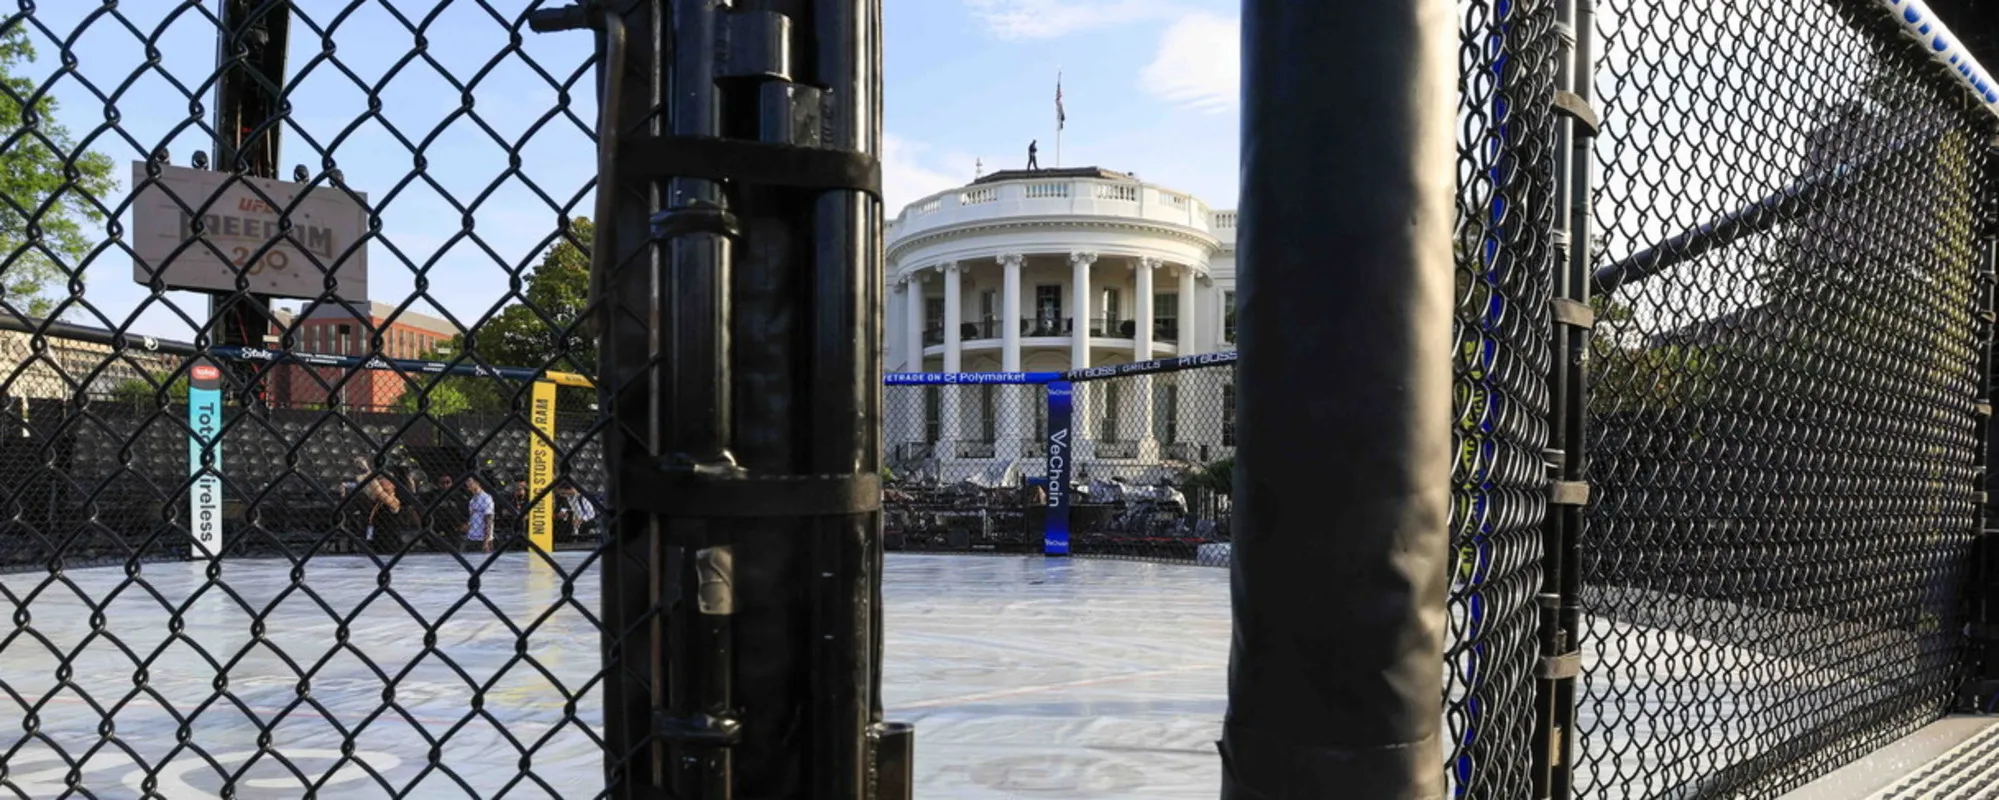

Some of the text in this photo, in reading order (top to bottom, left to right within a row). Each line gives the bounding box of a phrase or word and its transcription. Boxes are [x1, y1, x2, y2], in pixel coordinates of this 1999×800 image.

[238, 197, 274, 213] UFC
[241, 347, 272, 360] Stake
[959, 371, 1026, 383] Polymarket
[199, 402, 216, 543] Tota ireless
[532, 398, 549, 535] NOTHG STOPS RAM
[1050, 428, 1068, 507] VeChain
